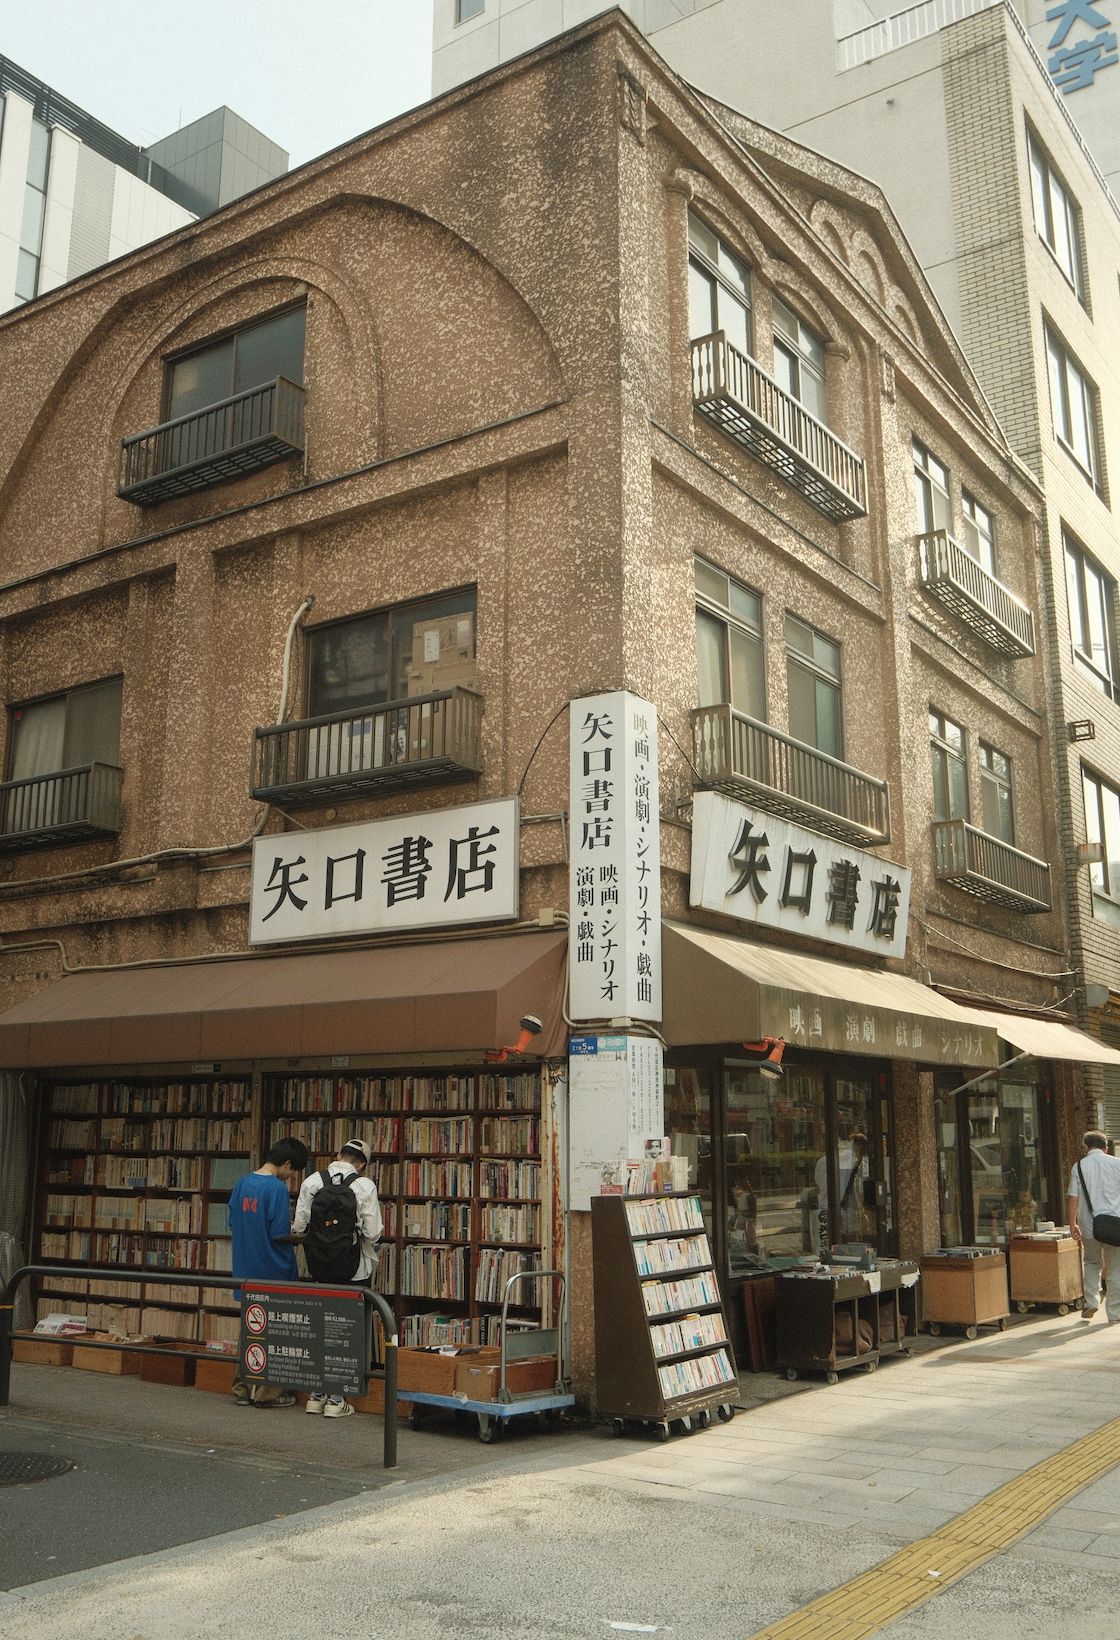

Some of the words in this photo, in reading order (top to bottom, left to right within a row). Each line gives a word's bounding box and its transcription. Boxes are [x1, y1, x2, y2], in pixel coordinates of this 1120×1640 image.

[580, 712, 614, 851] 矢口書店
[262, 825, 500, 923] 矢口書店
[633, 711, 653, 1004] 映画・演劇・シナリオ・戯曲
[726, 817, 902, 942] 矢口書店
[576, 867, 596, 963] 演劇・戯曲
[599, 863, 619, 1002] 映画・シナリオ
[788, 1004, 823, 1037] 映画
[846, 1014, 876, 1045] 演劇
[896, 1019, 923, 1049] 戯曲
[941, 1029, 984, 1057] シナリオ
[267, 1311, 311, 1325] 路上喫煙禁止
[267, 1345, 311, 1359] 路上駐輪禁止
